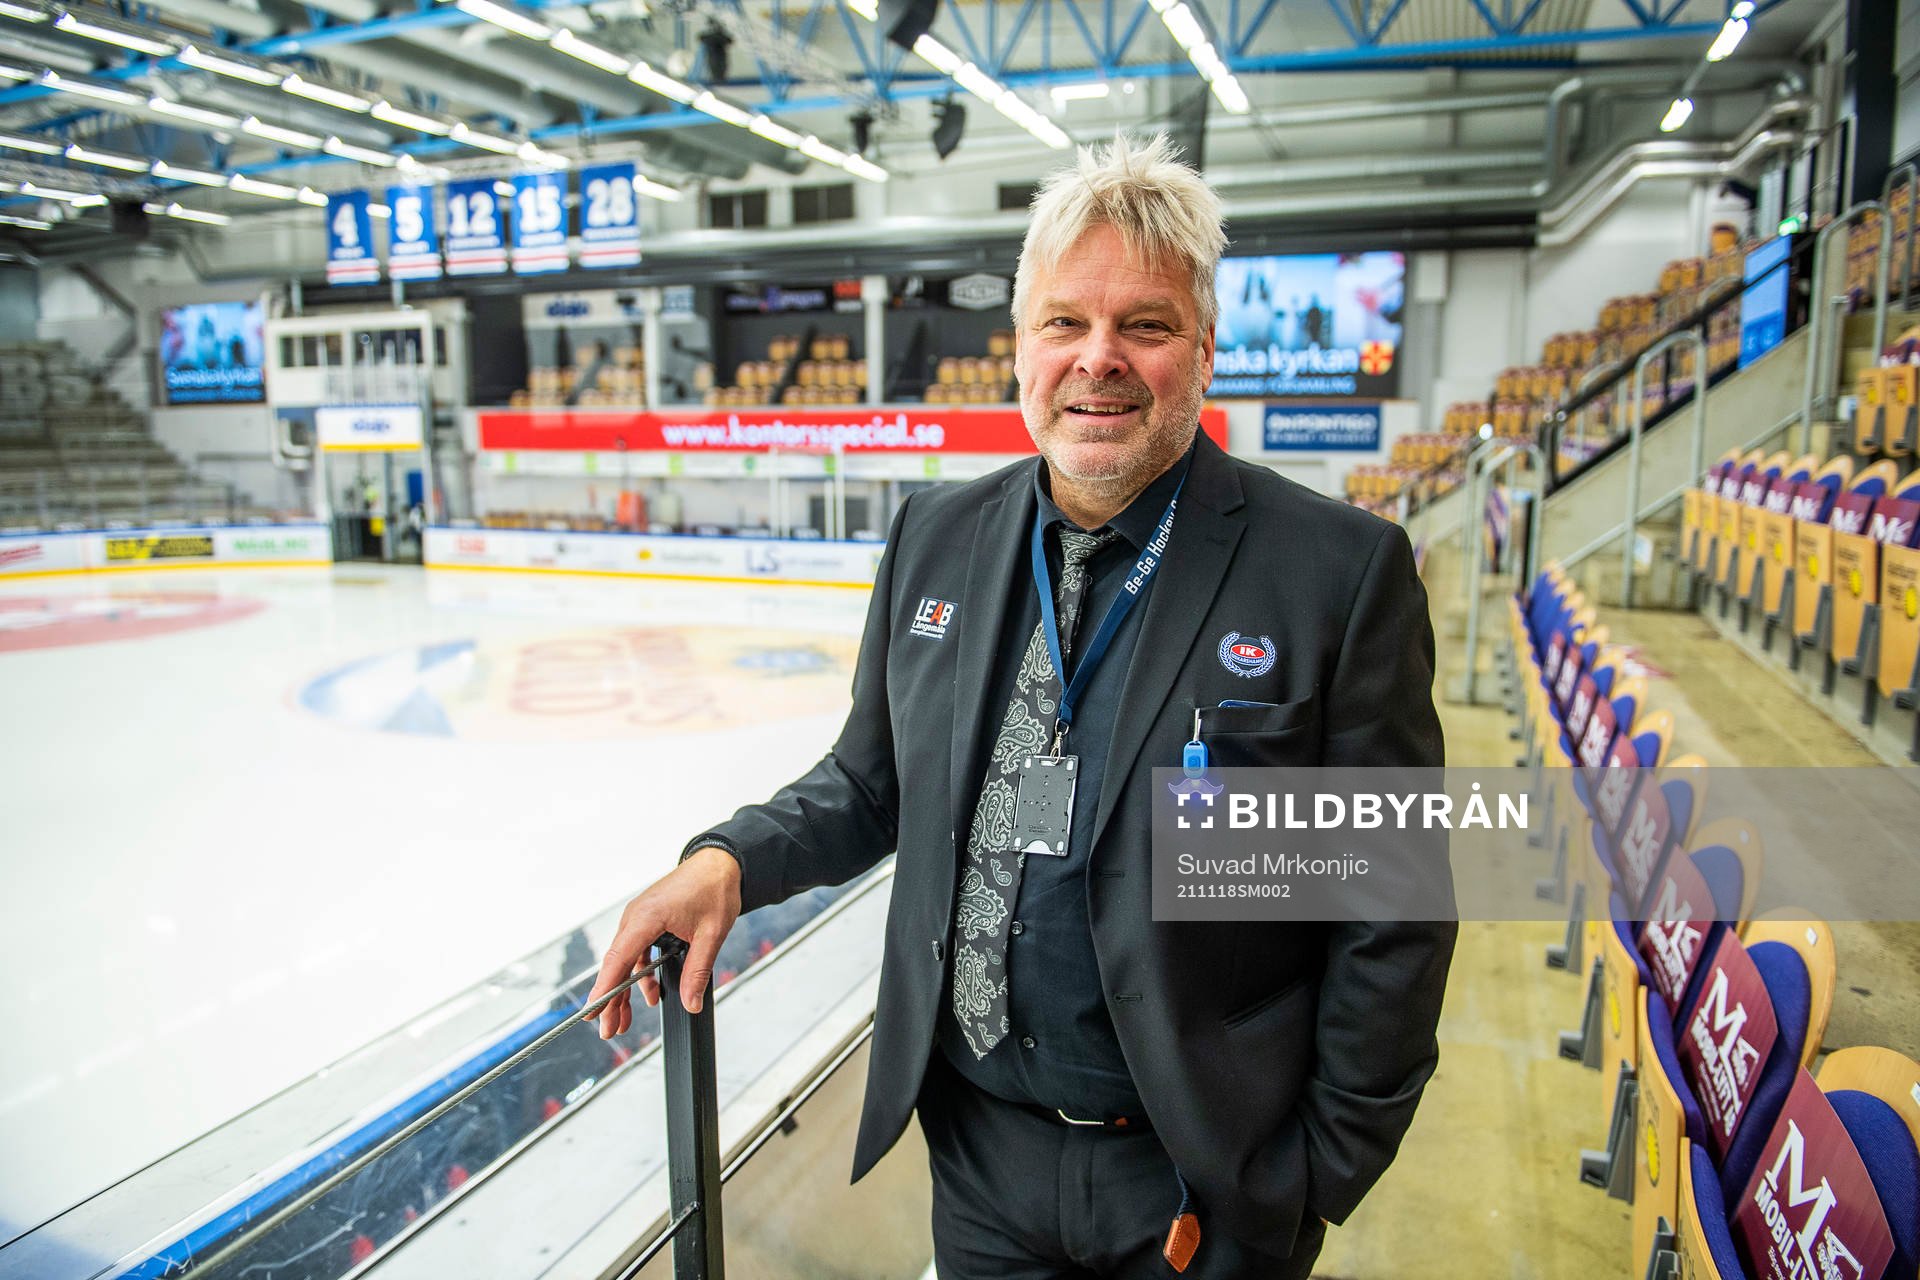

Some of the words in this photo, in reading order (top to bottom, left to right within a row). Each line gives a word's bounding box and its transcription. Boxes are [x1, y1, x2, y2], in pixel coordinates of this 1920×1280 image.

[333, 203, 358, 246] 4
[396, 197, 423, 242] 5
[450, 191, 497, 237] 12
[518, 186, 562, 233] 15
[1125, 557, 1155, 595] Be-Ge
[915, 599, 954, 626] LEAB
[1239, 646, 1257, 657] IK
